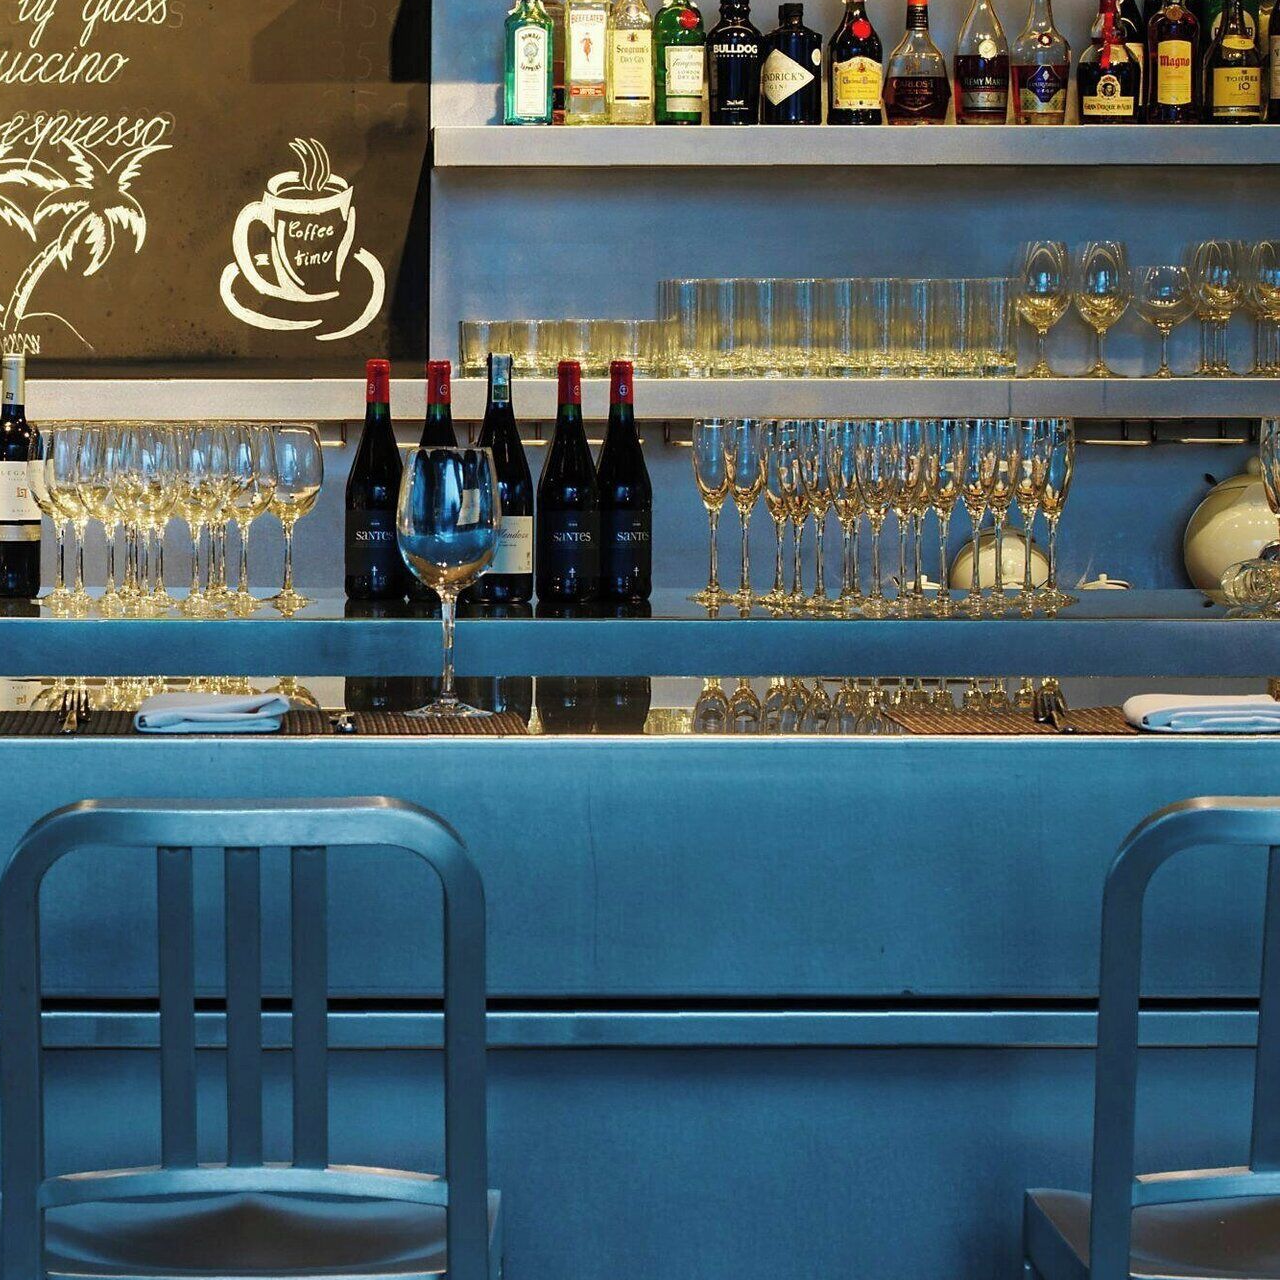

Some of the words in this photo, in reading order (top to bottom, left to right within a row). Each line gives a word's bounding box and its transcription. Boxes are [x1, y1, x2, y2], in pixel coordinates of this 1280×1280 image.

[571, 13, 605, 23] BEEFEATER
[520, 31, 543, 41] BOMBAY
[616, 44, 650, 55] Seagram's
[713, 44, 759, 55] BULLDOG
[619, 55, 633, 63] DRY
[633, 55, 645, 63] GIN
[1160, 55, 1190, 70] Magno
[1238, 82, 1251, 91] 10
[0, 115, 171, 171] espresso
[288, 221, 335, 241] Coffee
[294, 250, 333, 267] time
